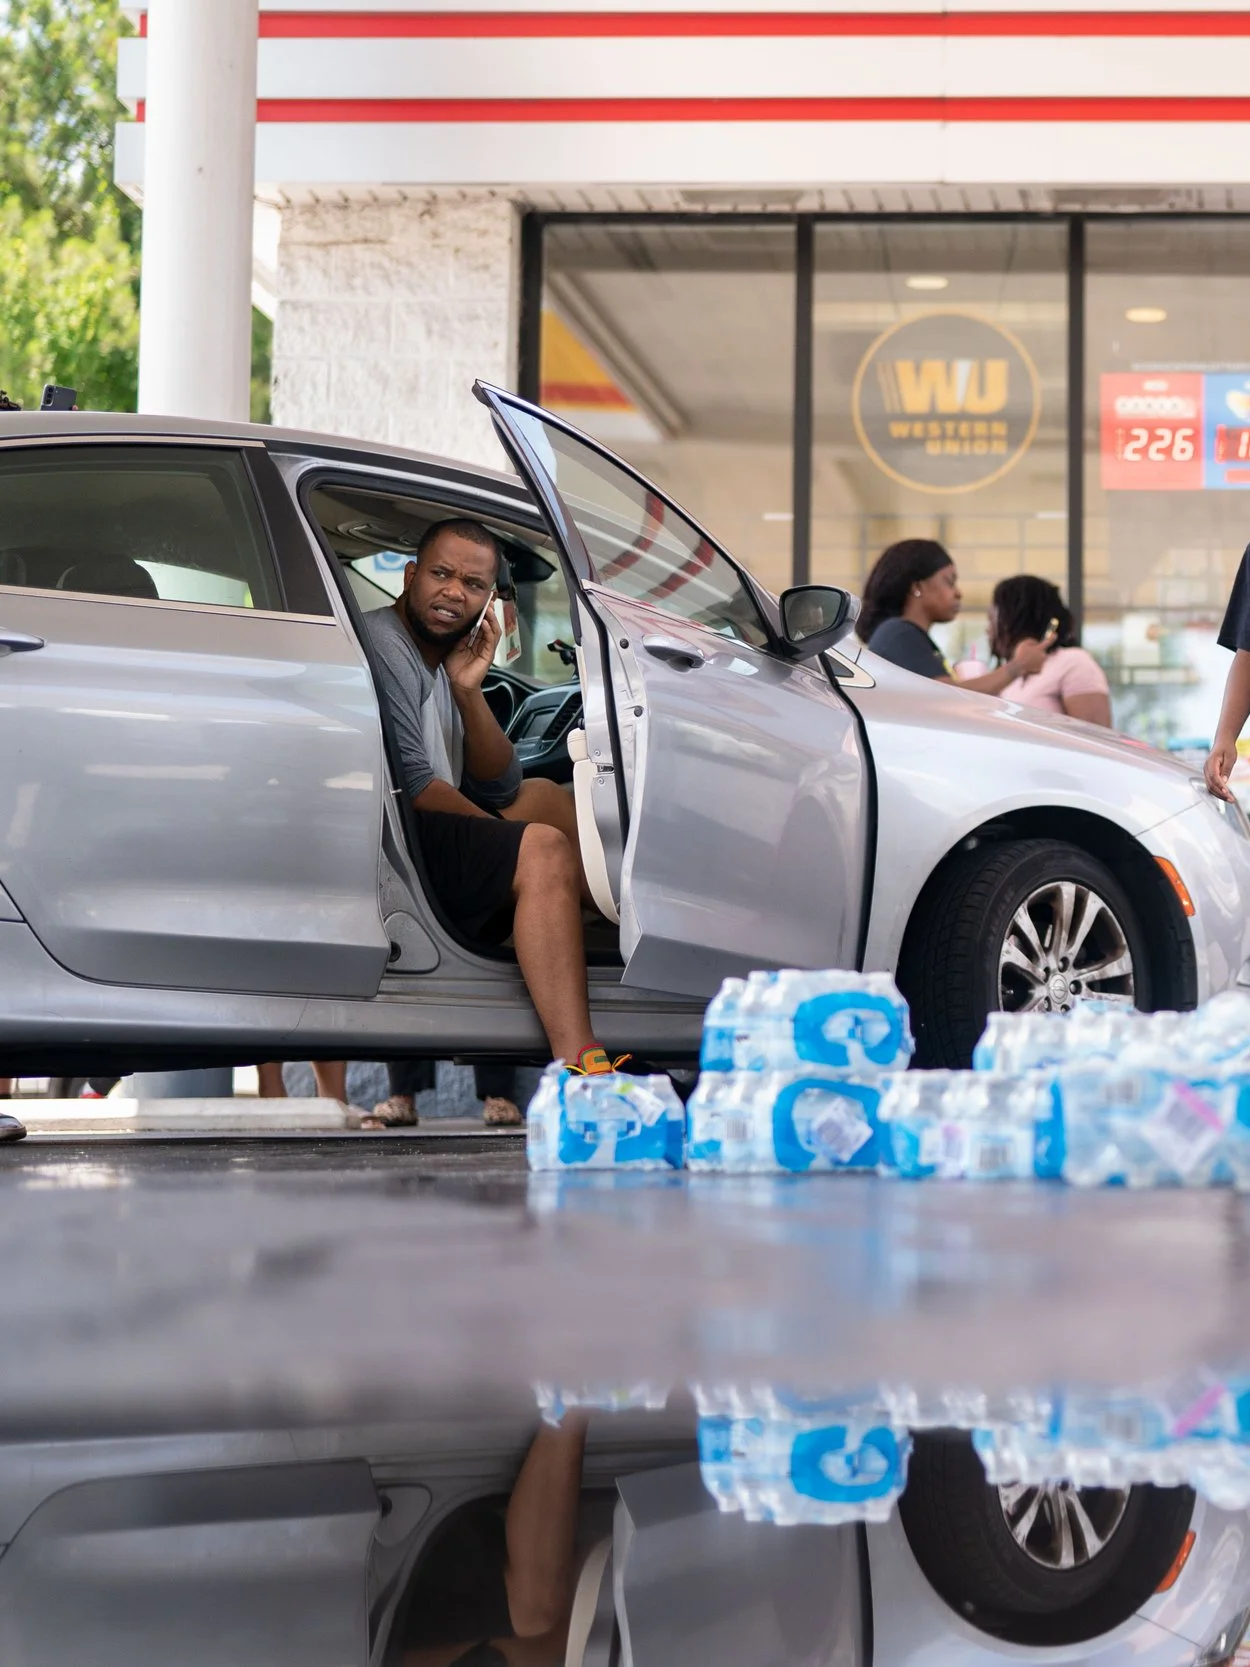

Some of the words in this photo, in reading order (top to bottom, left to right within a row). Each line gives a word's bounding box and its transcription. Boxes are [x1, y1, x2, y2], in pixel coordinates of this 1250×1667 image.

[889, 421, 1008, 438] WESTERN
[926, 440, 1008, 455] UNION
[1124, 428, 1194, 461] 226
